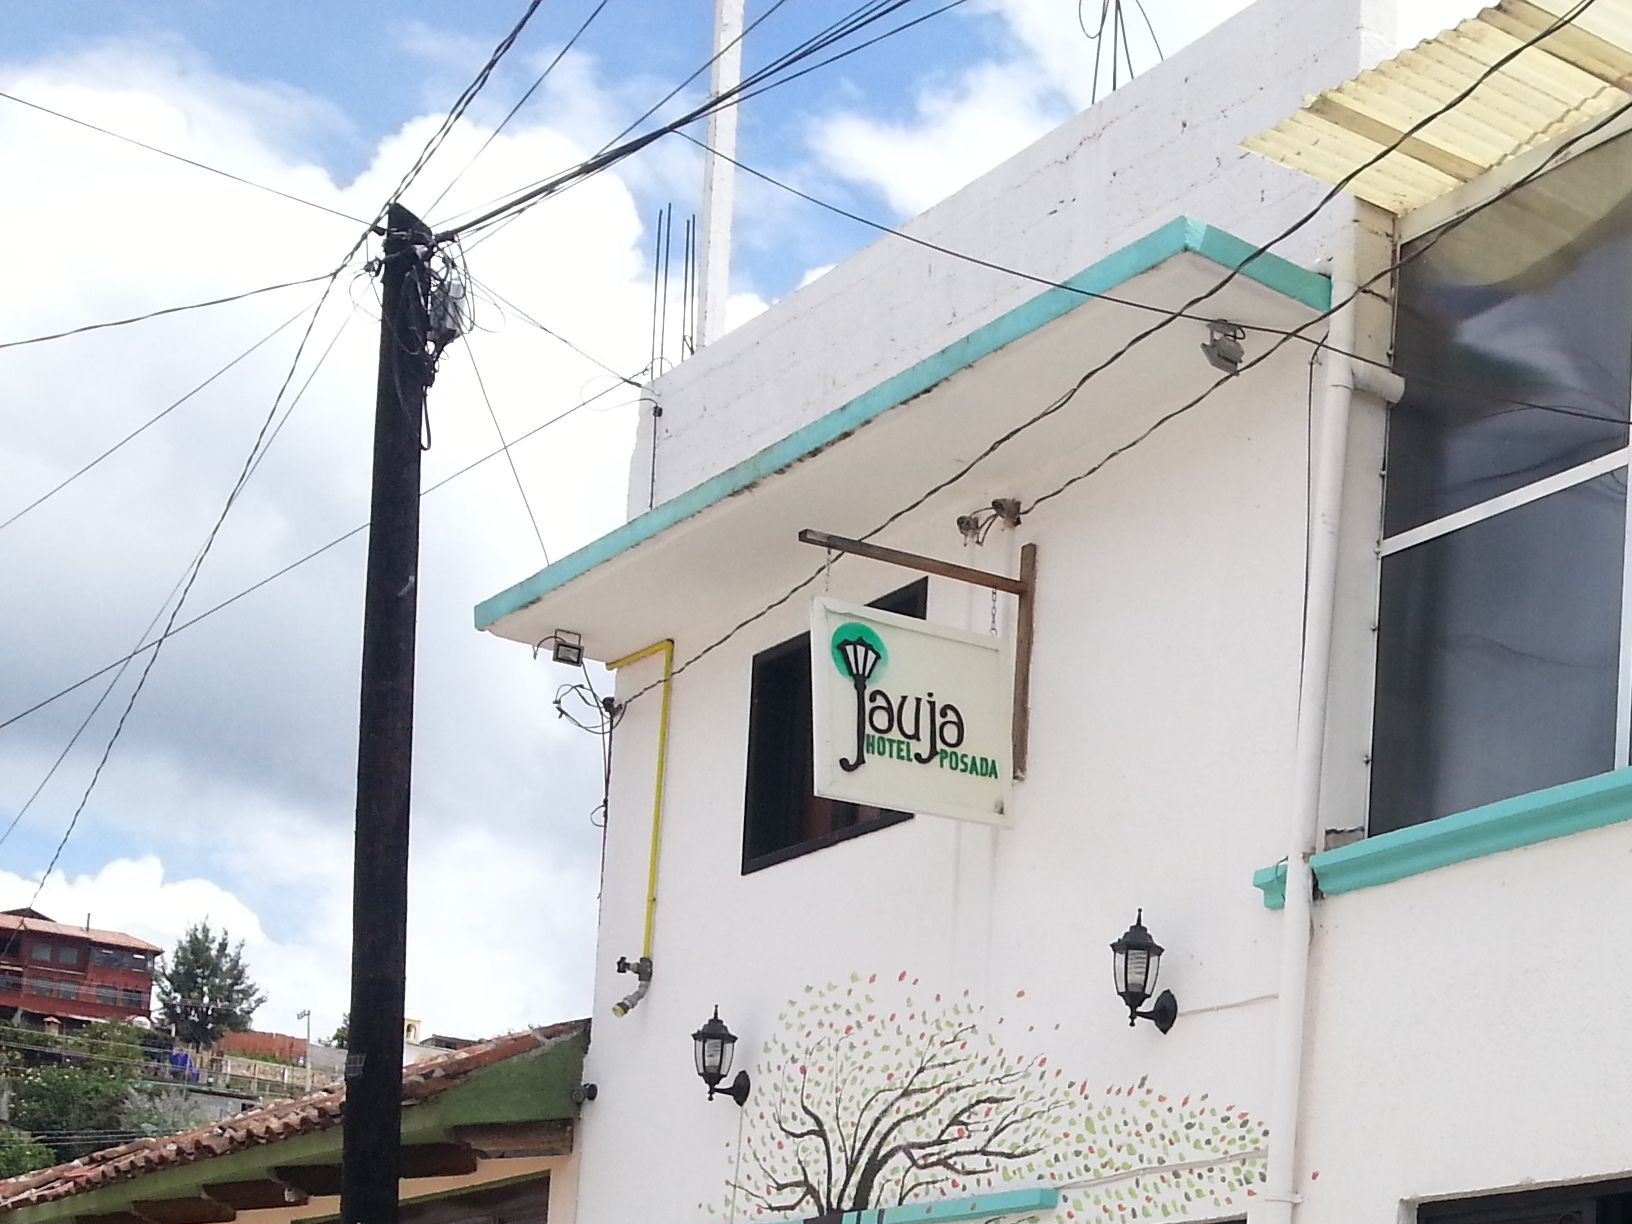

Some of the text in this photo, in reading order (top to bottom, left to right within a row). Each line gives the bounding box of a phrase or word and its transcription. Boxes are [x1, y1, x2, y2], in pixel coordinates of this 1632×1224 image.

[839, 674, 965, 772] Jauja
[865, 734, 998, 779] HOTEL POSADA
